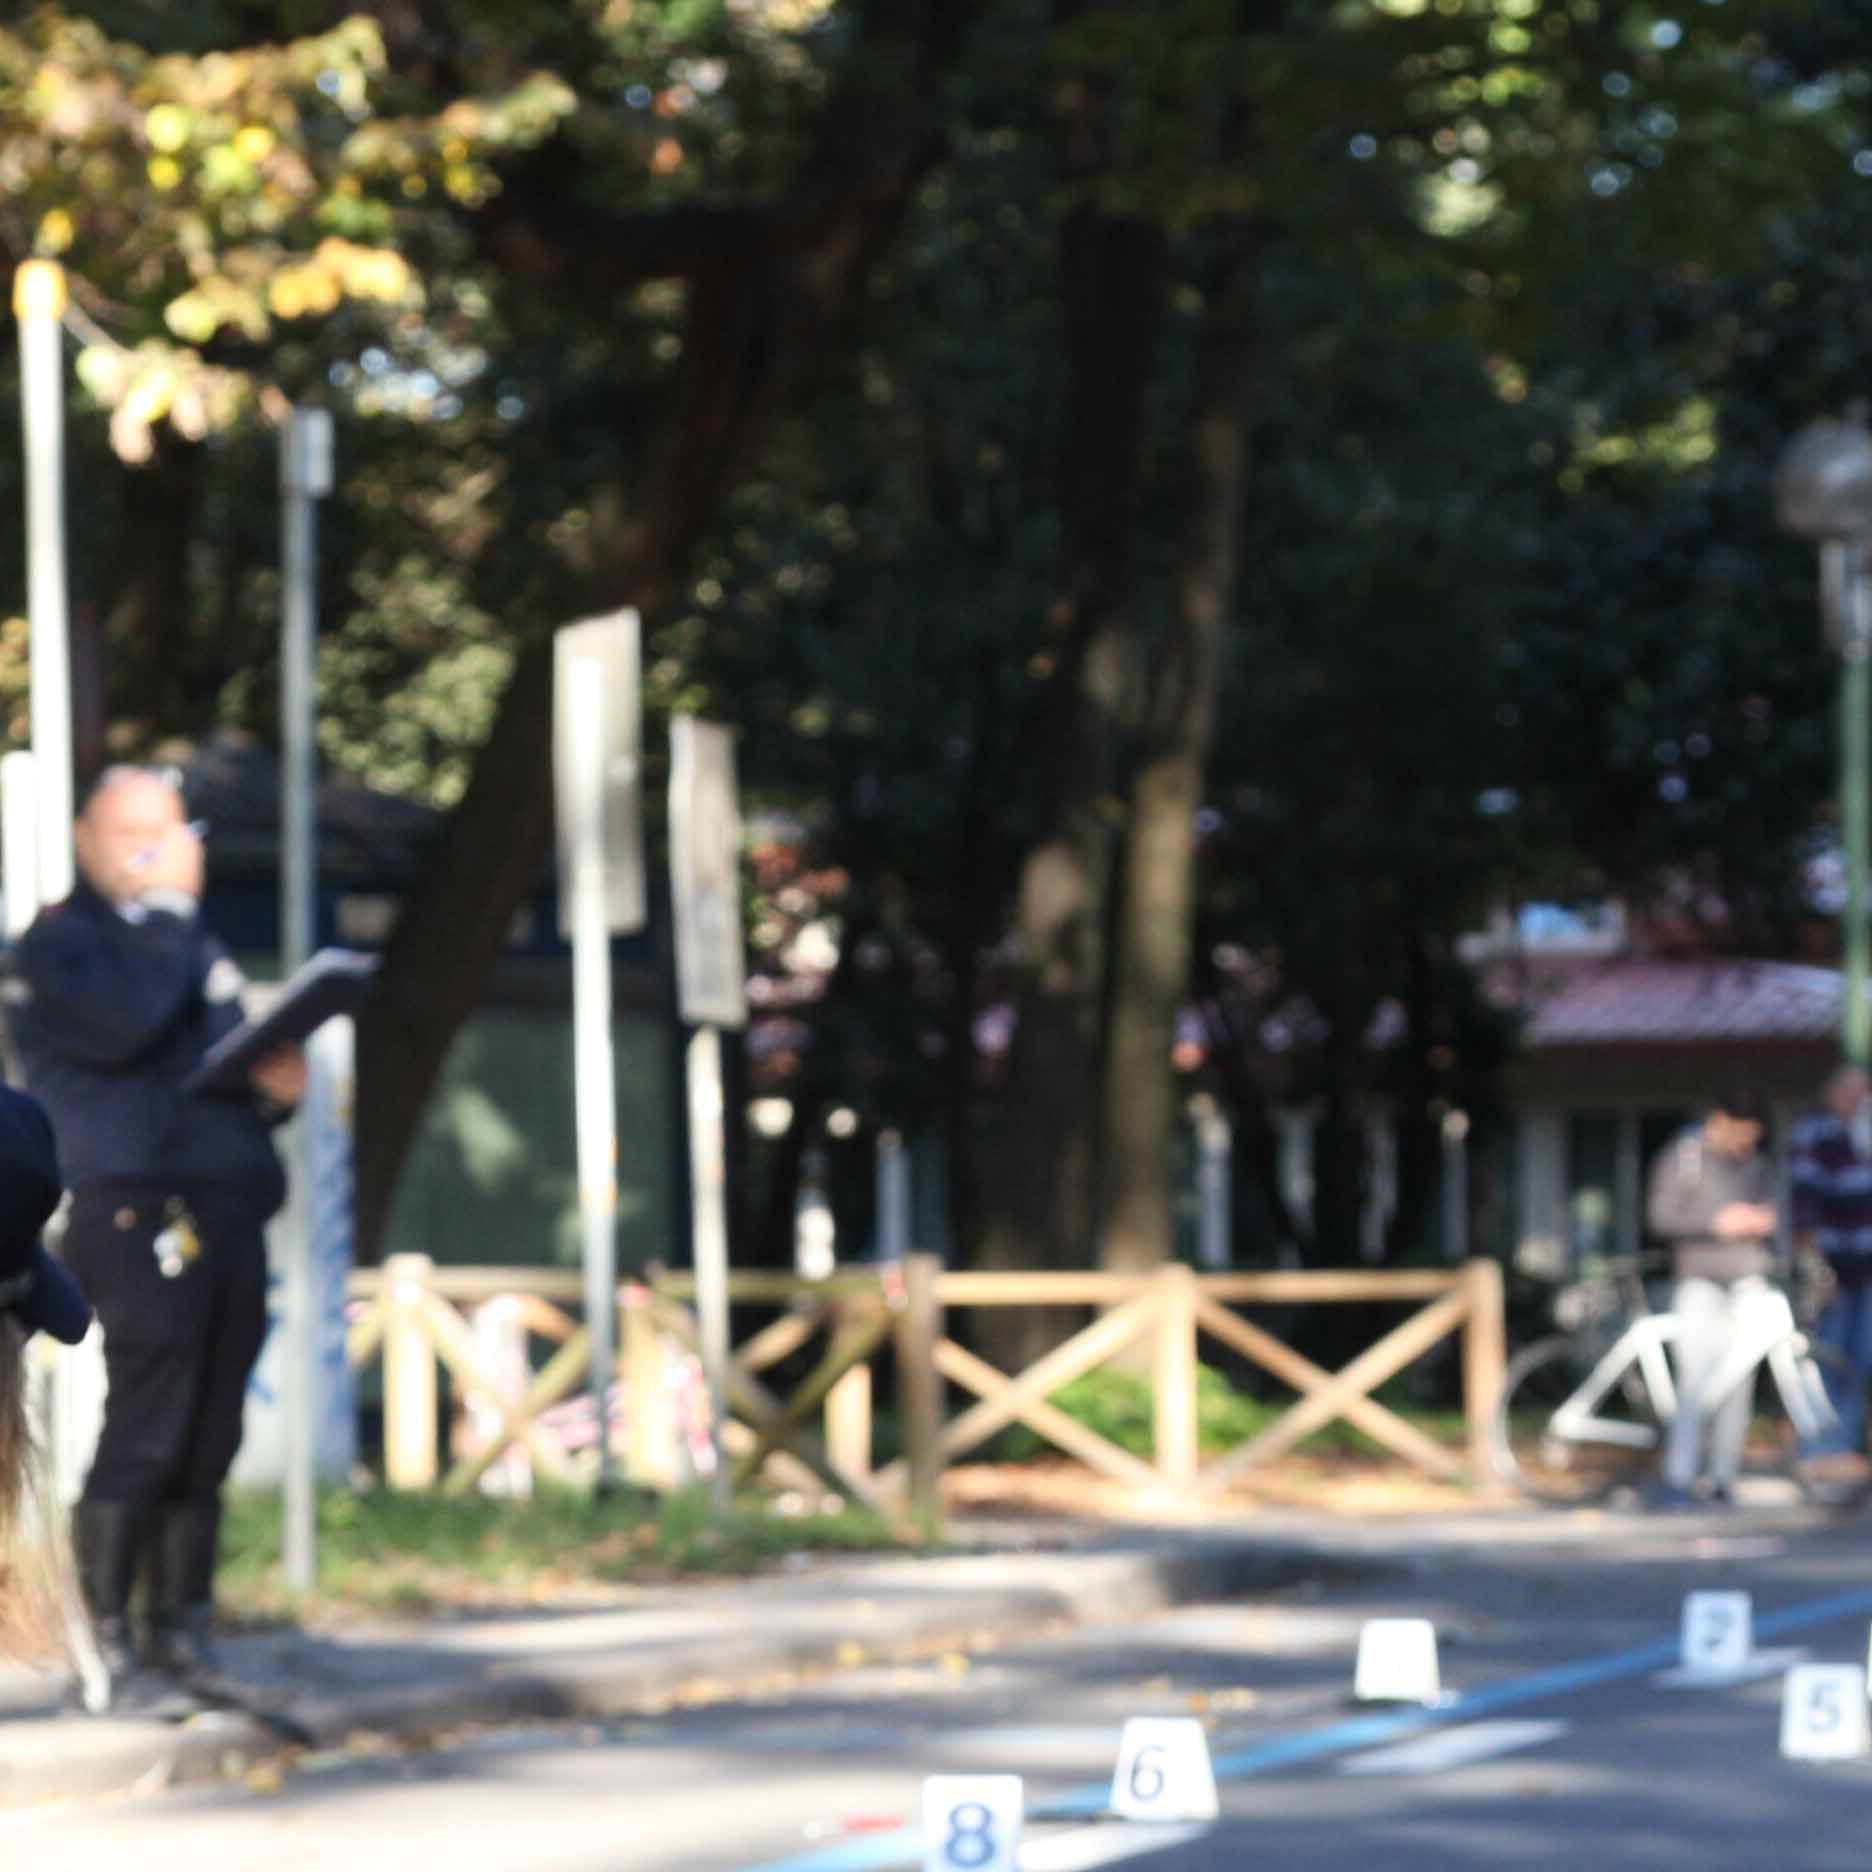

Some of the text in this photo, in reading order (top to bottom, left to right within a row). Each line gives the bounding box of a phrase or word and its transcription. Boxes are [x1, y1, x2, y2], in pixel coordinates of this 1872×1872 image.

[1809, 1678, 1842, 1732] 5
[1130, 1744, 1164, 1802] 6
[945, 1801, 995, 1868] 8
